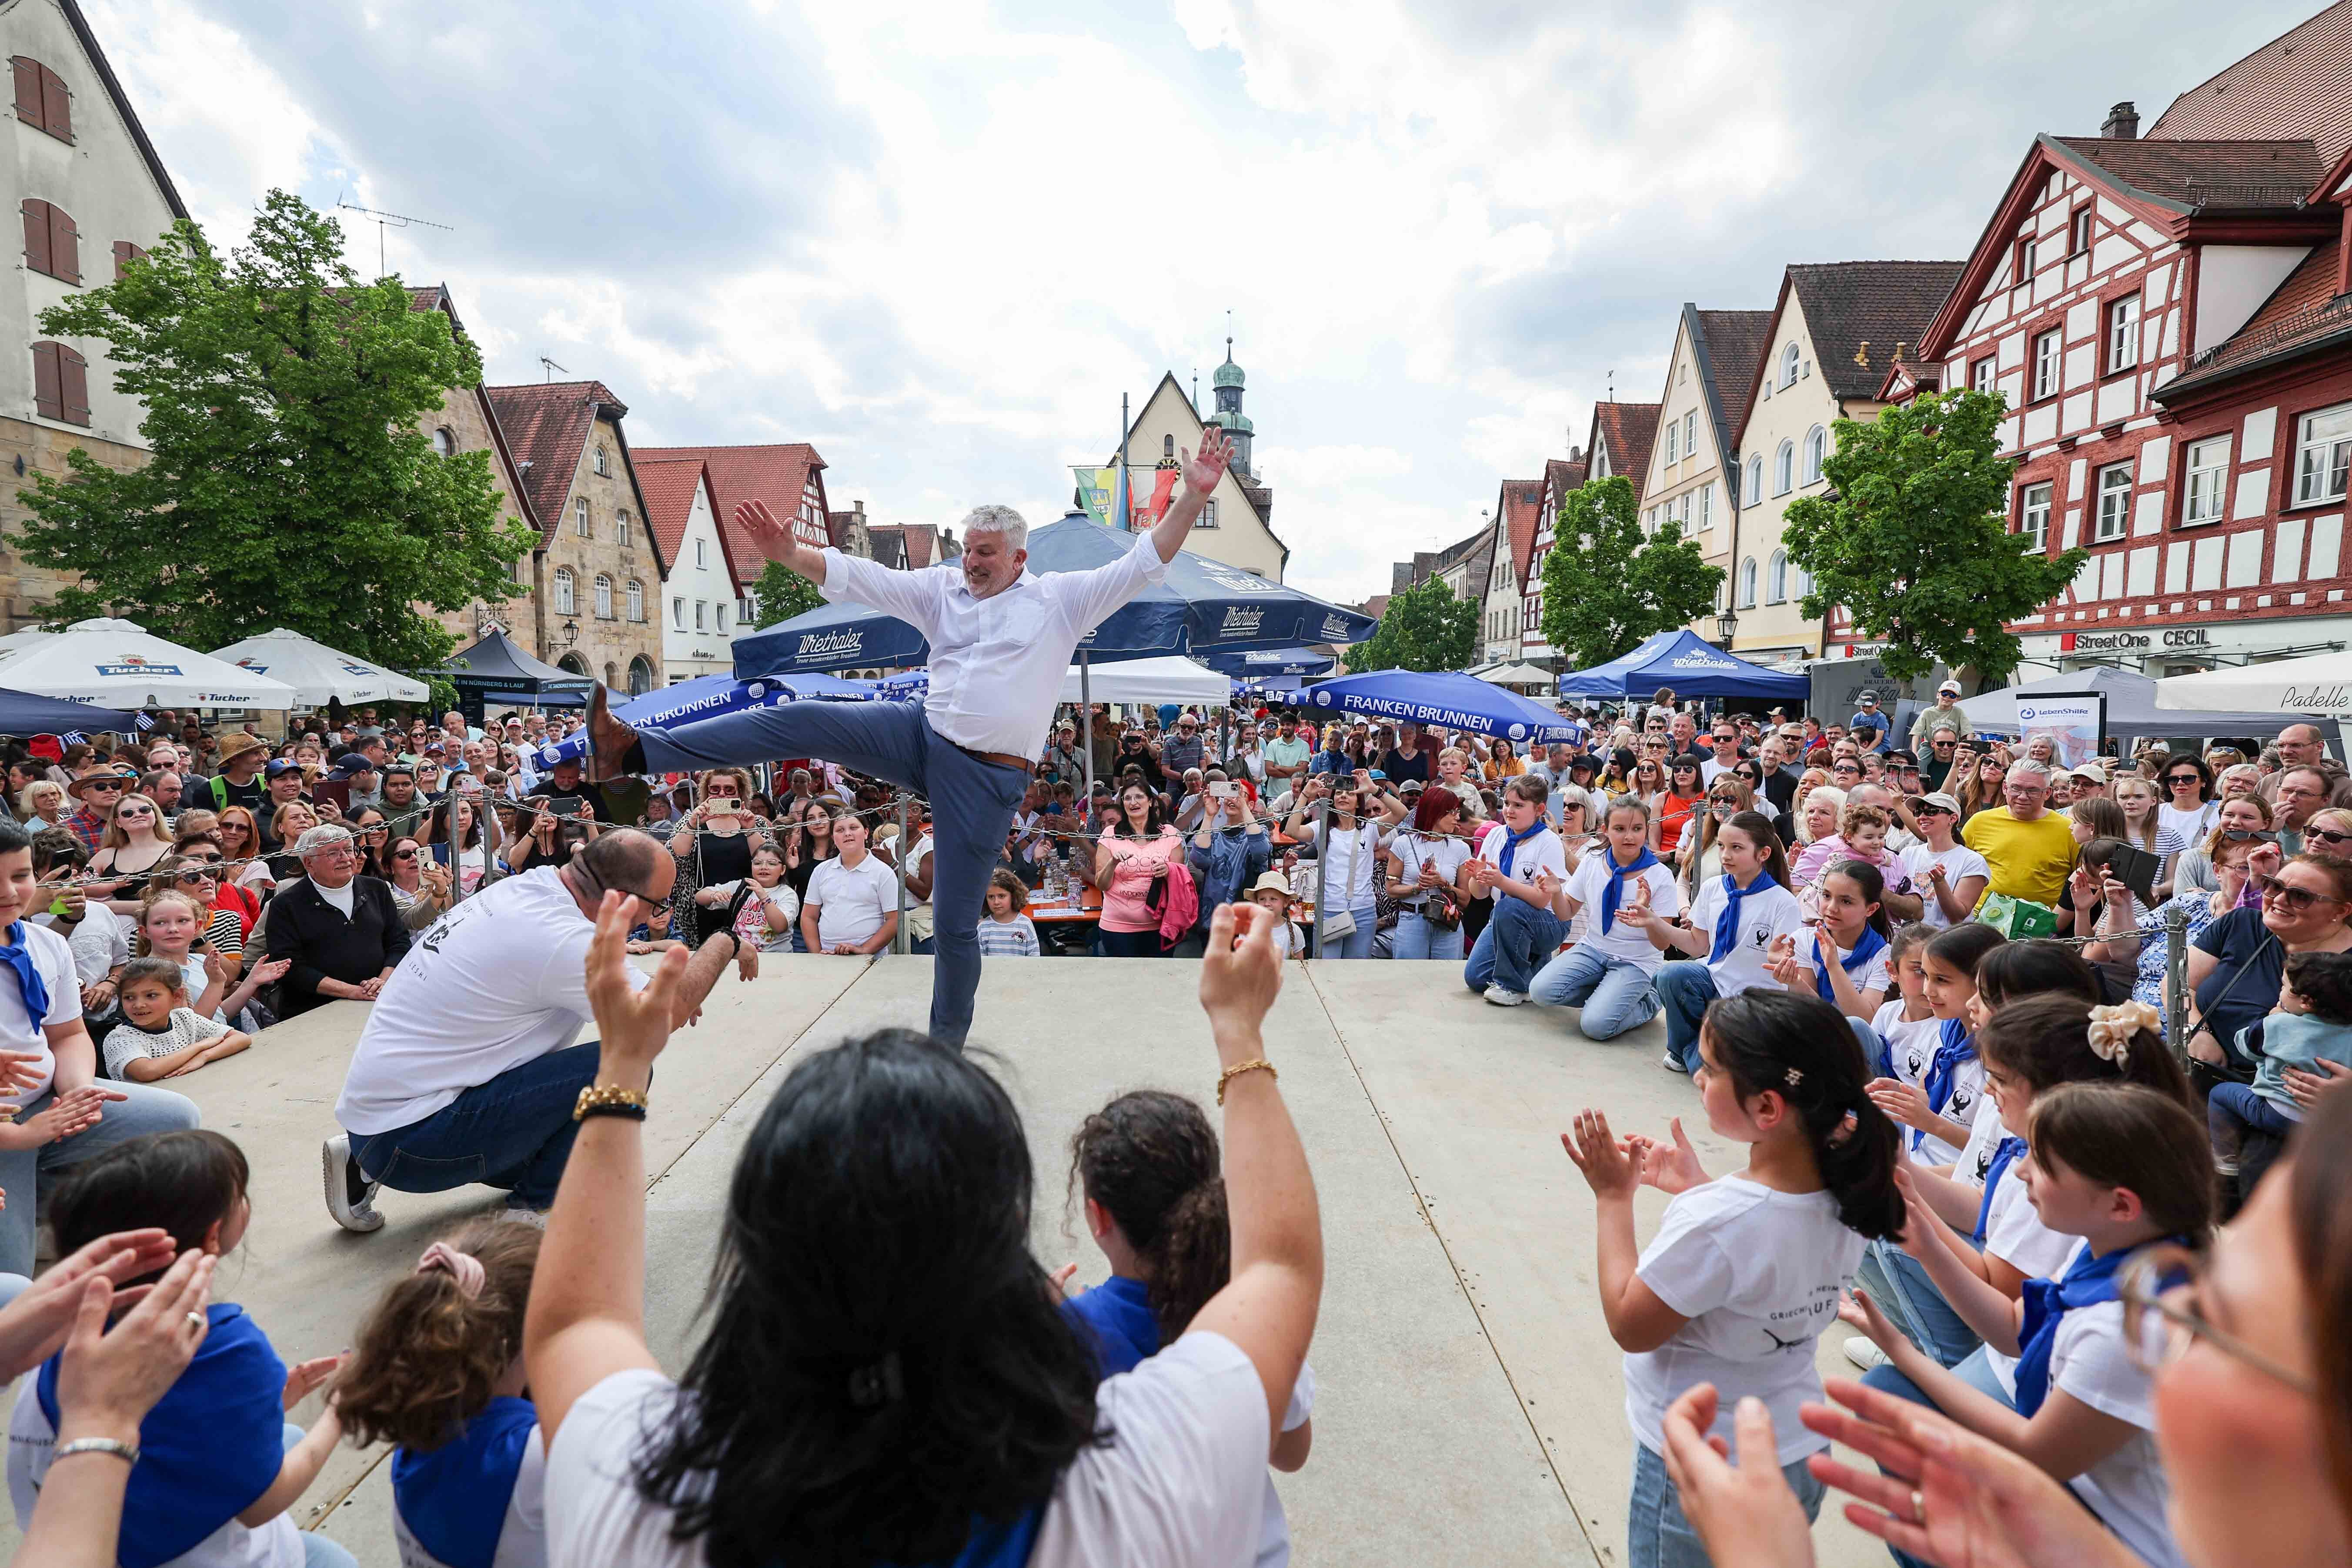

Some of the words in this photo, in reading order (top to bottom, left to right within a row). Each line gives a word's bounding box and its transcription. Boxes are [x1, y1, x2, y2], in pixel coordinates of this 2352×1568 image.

[1223, 606, 1264, 627] Wiethaler
[1323, 613, 1350, 633] Wiethaler
[798, 628, 863, 654] Wiethaler
[2076, 634, 2118, 648] Street
[2118, 633, 2150, 647] One
[2163, 629, 2210, 645] CECIL
[1189, 655, 1210, 665] thaler
[1853, 645, 1874, 656] Street
[1670, 658, 1737, 666] Wiethaler
[468, 679, 502, 687] NÜRNBERG
[2281, 685, 2349, 708] Padelle
[654, 691, 732, 723] BRUNNEN
[1344, 695, 1416, 717] FRANKEN
[1417, 706, 1493, 731] BRUNNEN
[1545, 727, 1563, 740] FRANKEN
